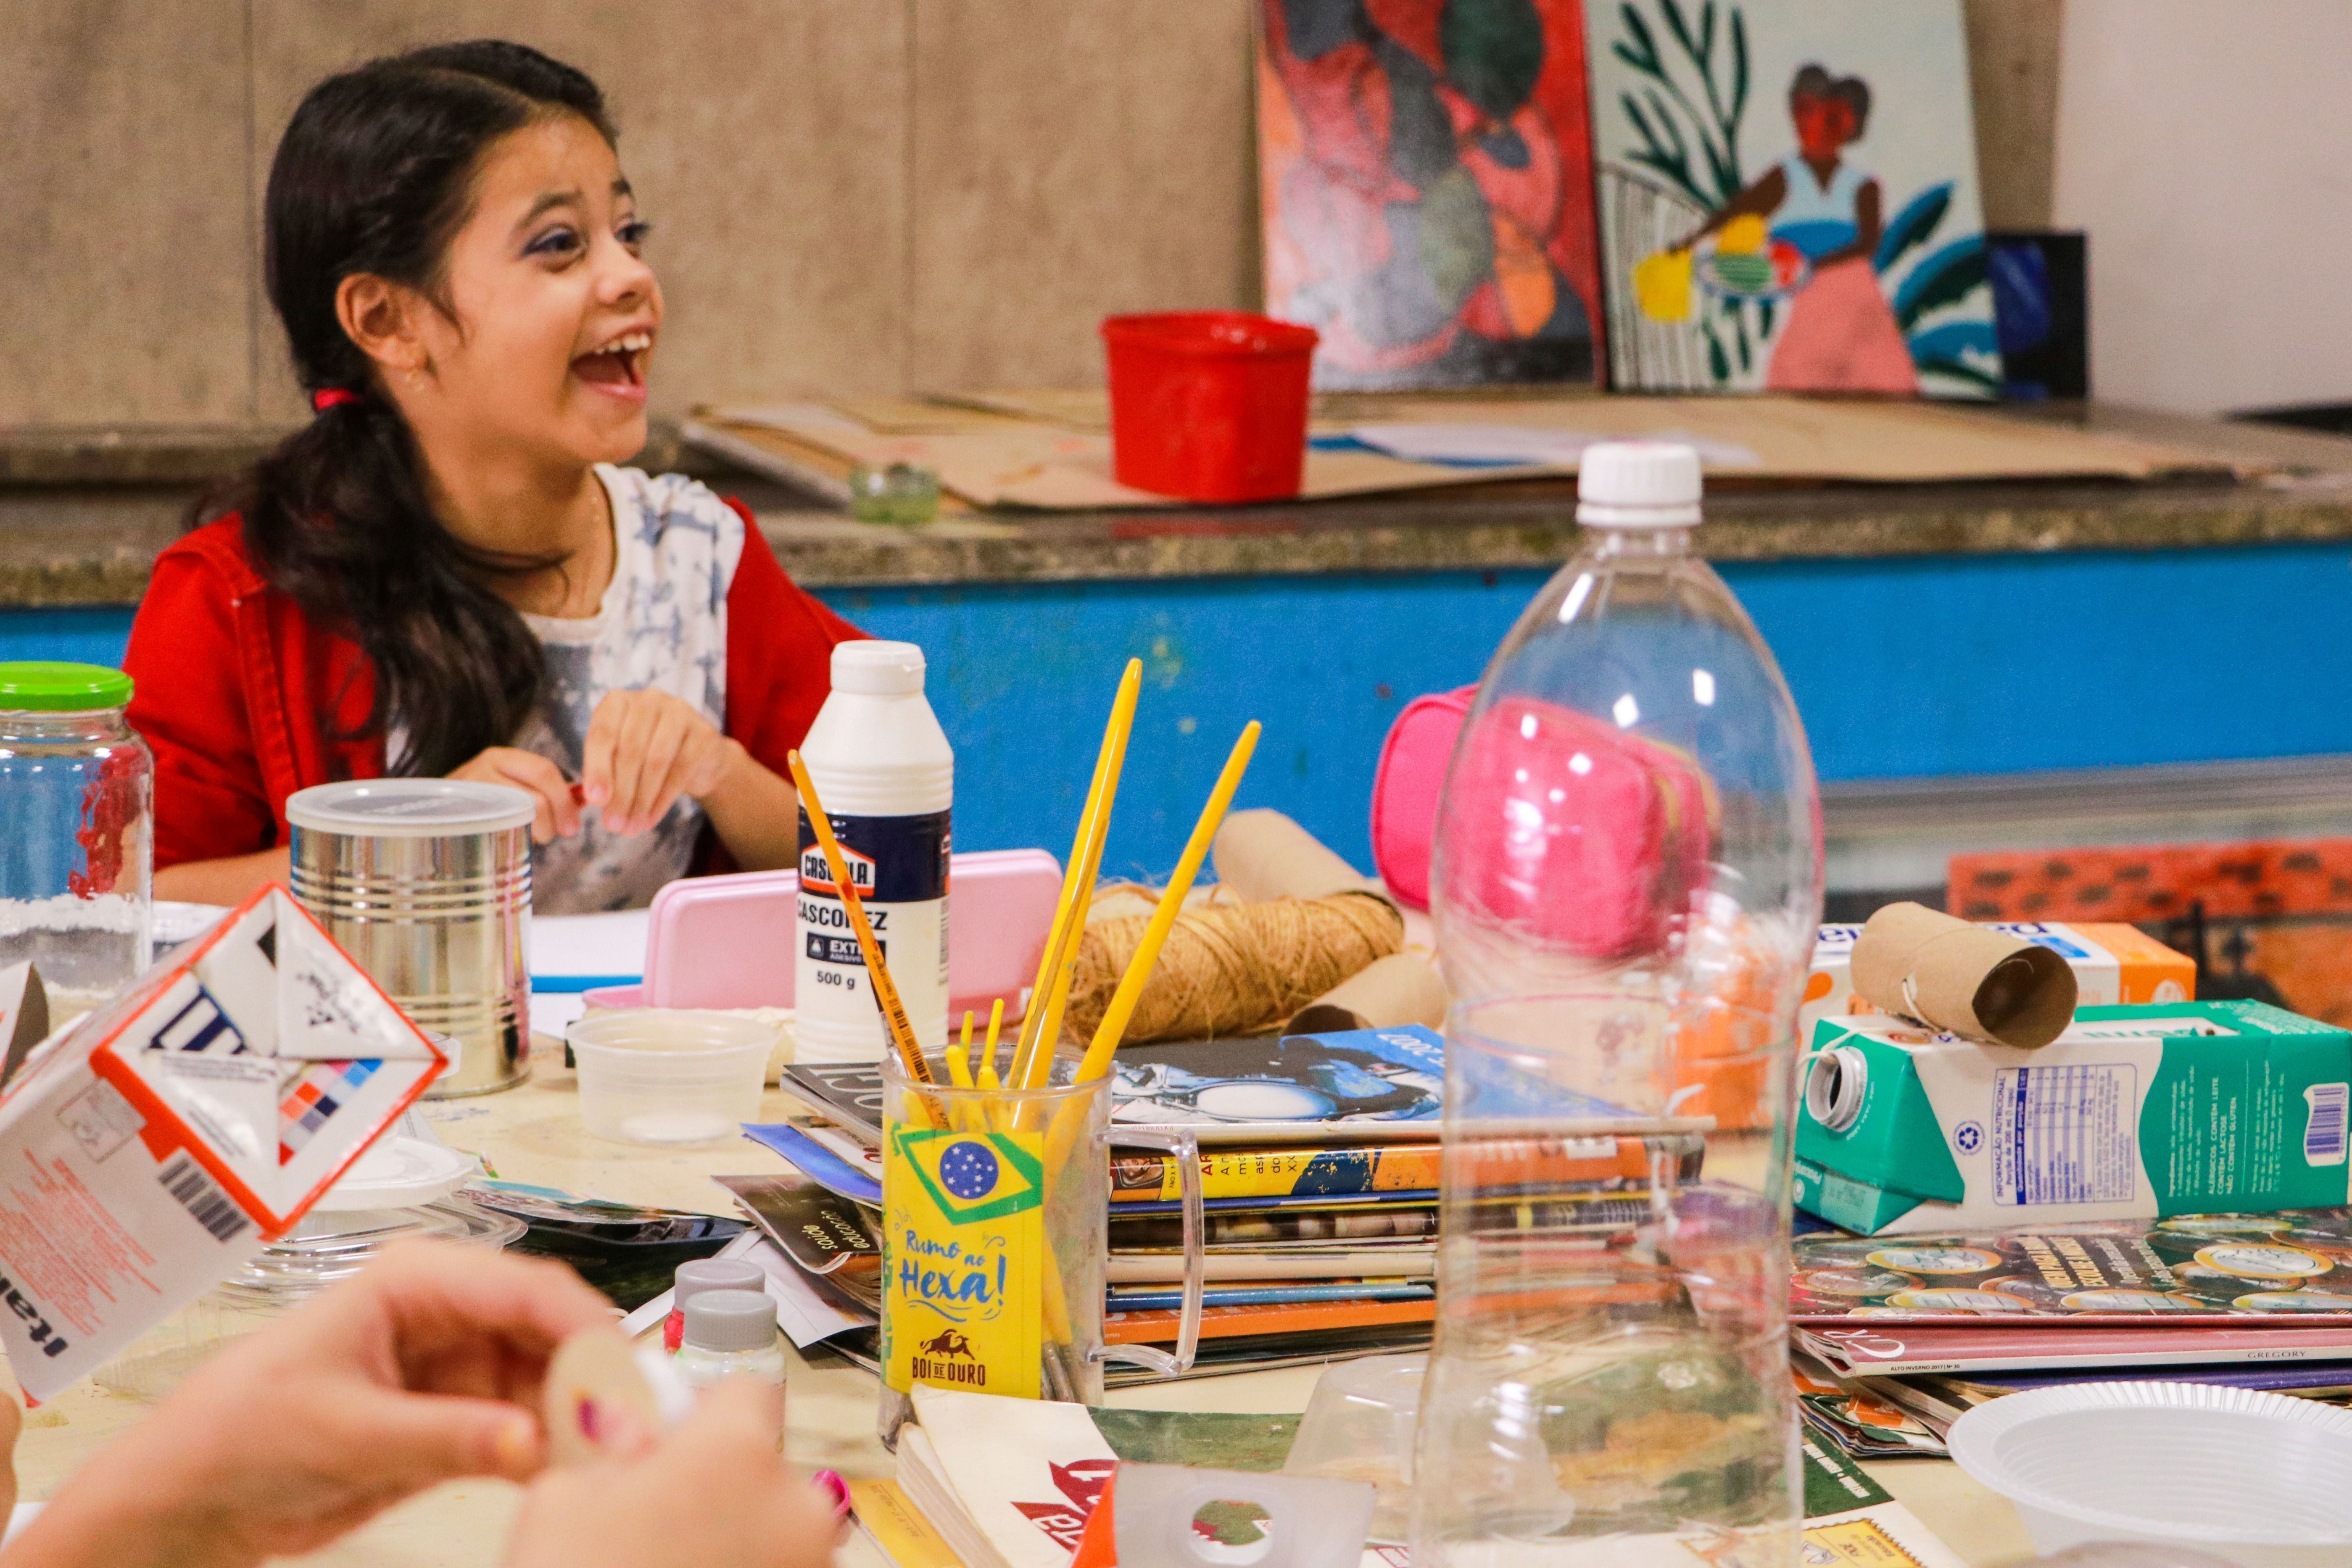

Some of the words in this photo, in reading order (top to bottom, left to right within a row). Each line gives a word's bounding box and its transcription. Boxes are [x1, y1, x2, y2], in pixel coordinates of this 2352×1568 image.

[817, 971, 841, 986] 500
[847, 978, 855, 989] g
[1996, 1078, 2005, 1134] NUTRICIONAL
[1994, 1138, 2004, 1197] INFORMAÇÃO
[2225, 1175, 2233, 1194] NÃO
[802, 1224, 838, 1249] saúde
[905, 1230, 961, 1259] Rumo
[899, 1254, 1006, 1306] Hexa!
[2248, 1350, 2306, 1359] GREGORY
[912, 1356, 931, 1379] BOI
[934, 1365, 944, 1377] DE
[947, 1362, 986, 1386] OURO
